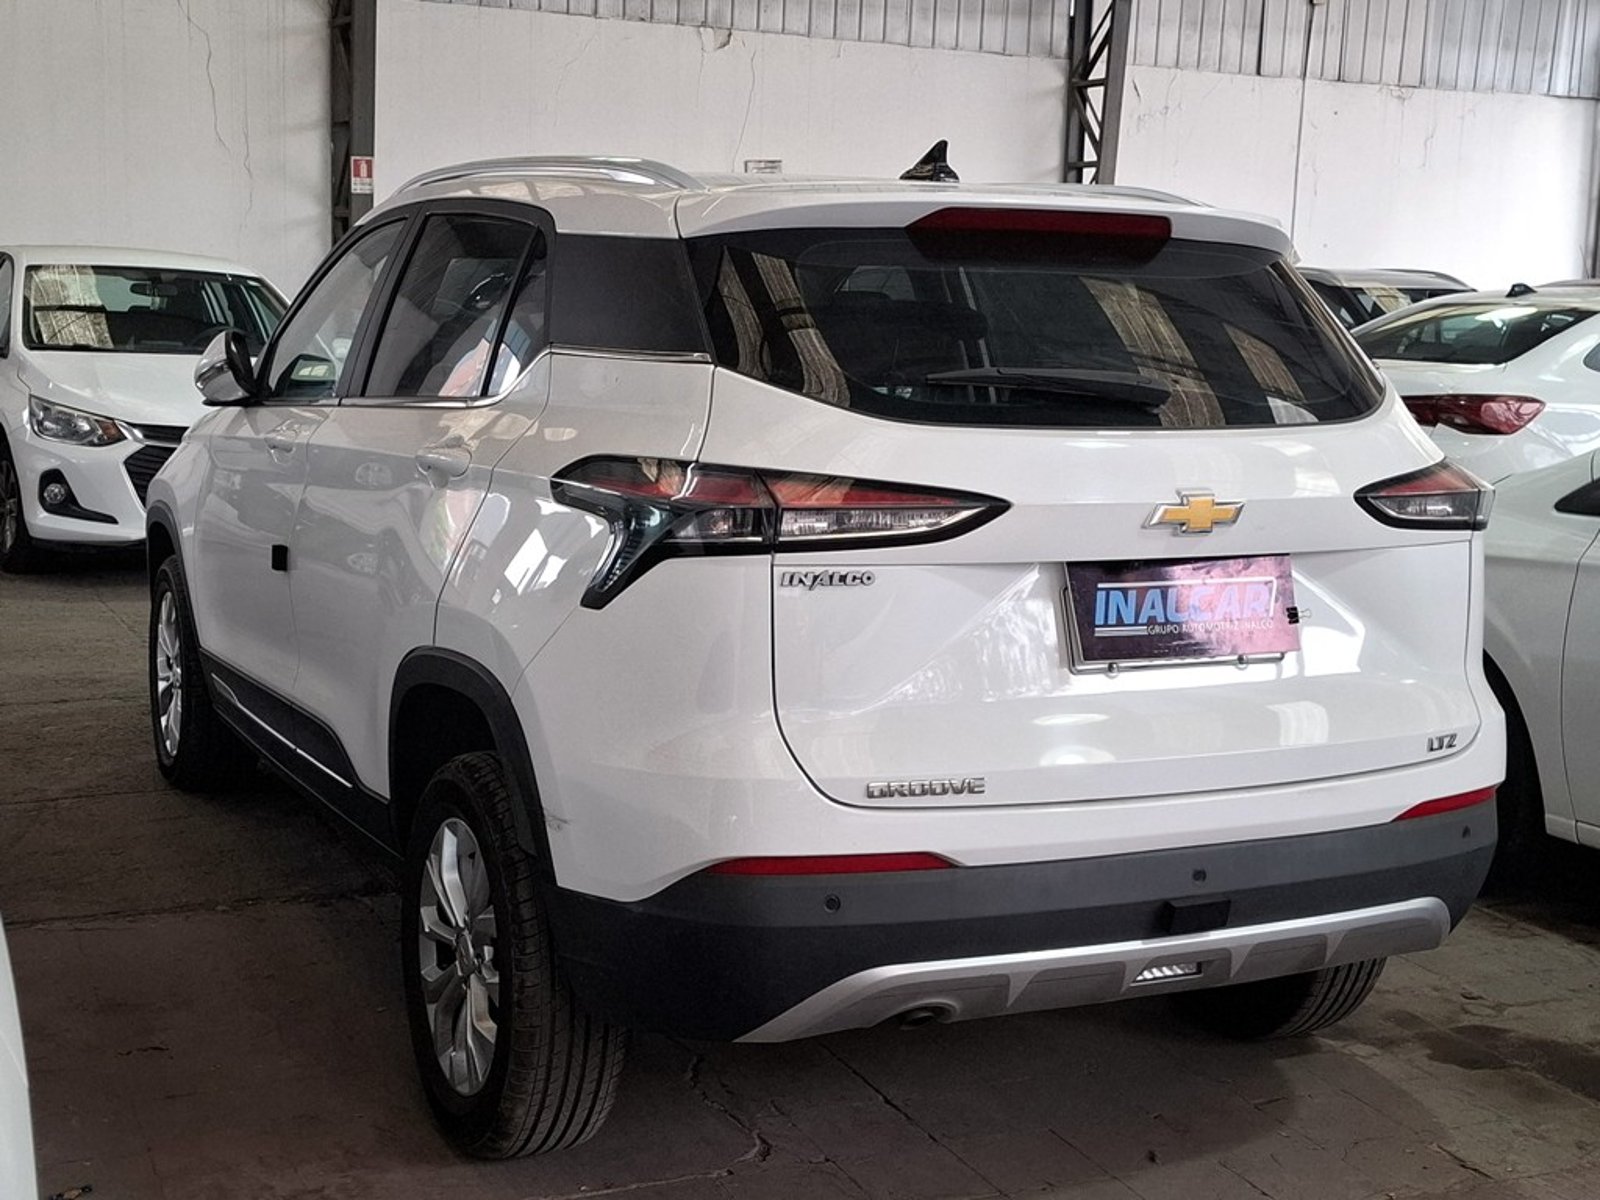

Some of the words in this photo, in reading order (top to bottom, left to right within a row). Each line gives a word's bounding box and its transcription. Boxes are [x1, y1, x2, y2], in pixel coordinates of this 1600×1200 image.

[780, 570, 876, 591] INALCO
[1094, 584, 1270, 626] INALCAR
[1147, 624, 1180, 635] GRUPO
[1427, 733, 1457, 752] LTZ
[866, 777, 986, 799] GROOVE
